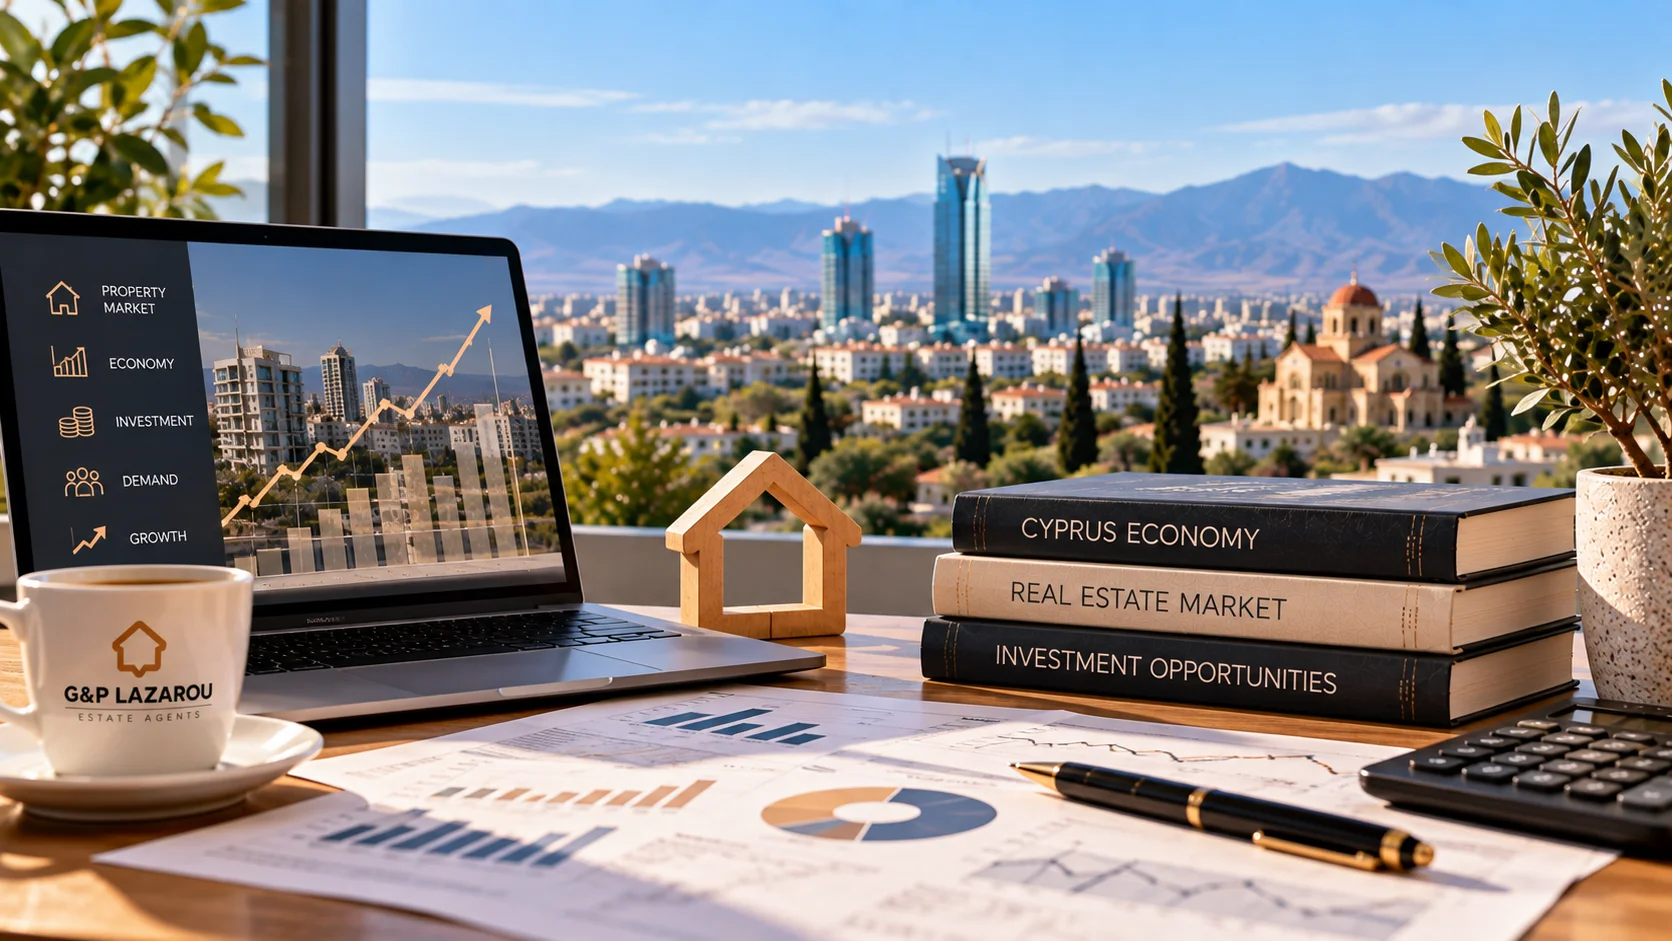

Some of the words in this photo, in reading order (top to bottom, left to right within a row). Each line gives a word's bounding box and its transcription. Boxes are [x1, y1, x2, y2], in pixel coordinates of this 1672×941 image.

[102, 285, 166, 298] PROPERTY
[104, 302, 155, 314] MARKET
[109, 358, 175, 370] ECONOMY
[115, 415, 194, 428] INVESTMENT
[122, 474, 179, 487] DEMAND
[129, 530, 187, 544] GROWTH
[1021, 517, 1117, 543] CYPRUS
[1127, 521, 1260, 550] ECONOMY
[1011, 581, 1072, 606] REAL
[1081, 586, 1169, 613] ESTATE
[1180, 593, 1288, 621] MARKET
[995, 644, 1143, 677] INVESTMENT
[1150, 657, 1338, 695] OPPORTUNITIES
[64, 685, 109, 703] G&P
[115, 682, 213, 704] LAZAROU
[78, 713, 133, 723] ESTATE
[144, 710, 200, 723] AGENTS
